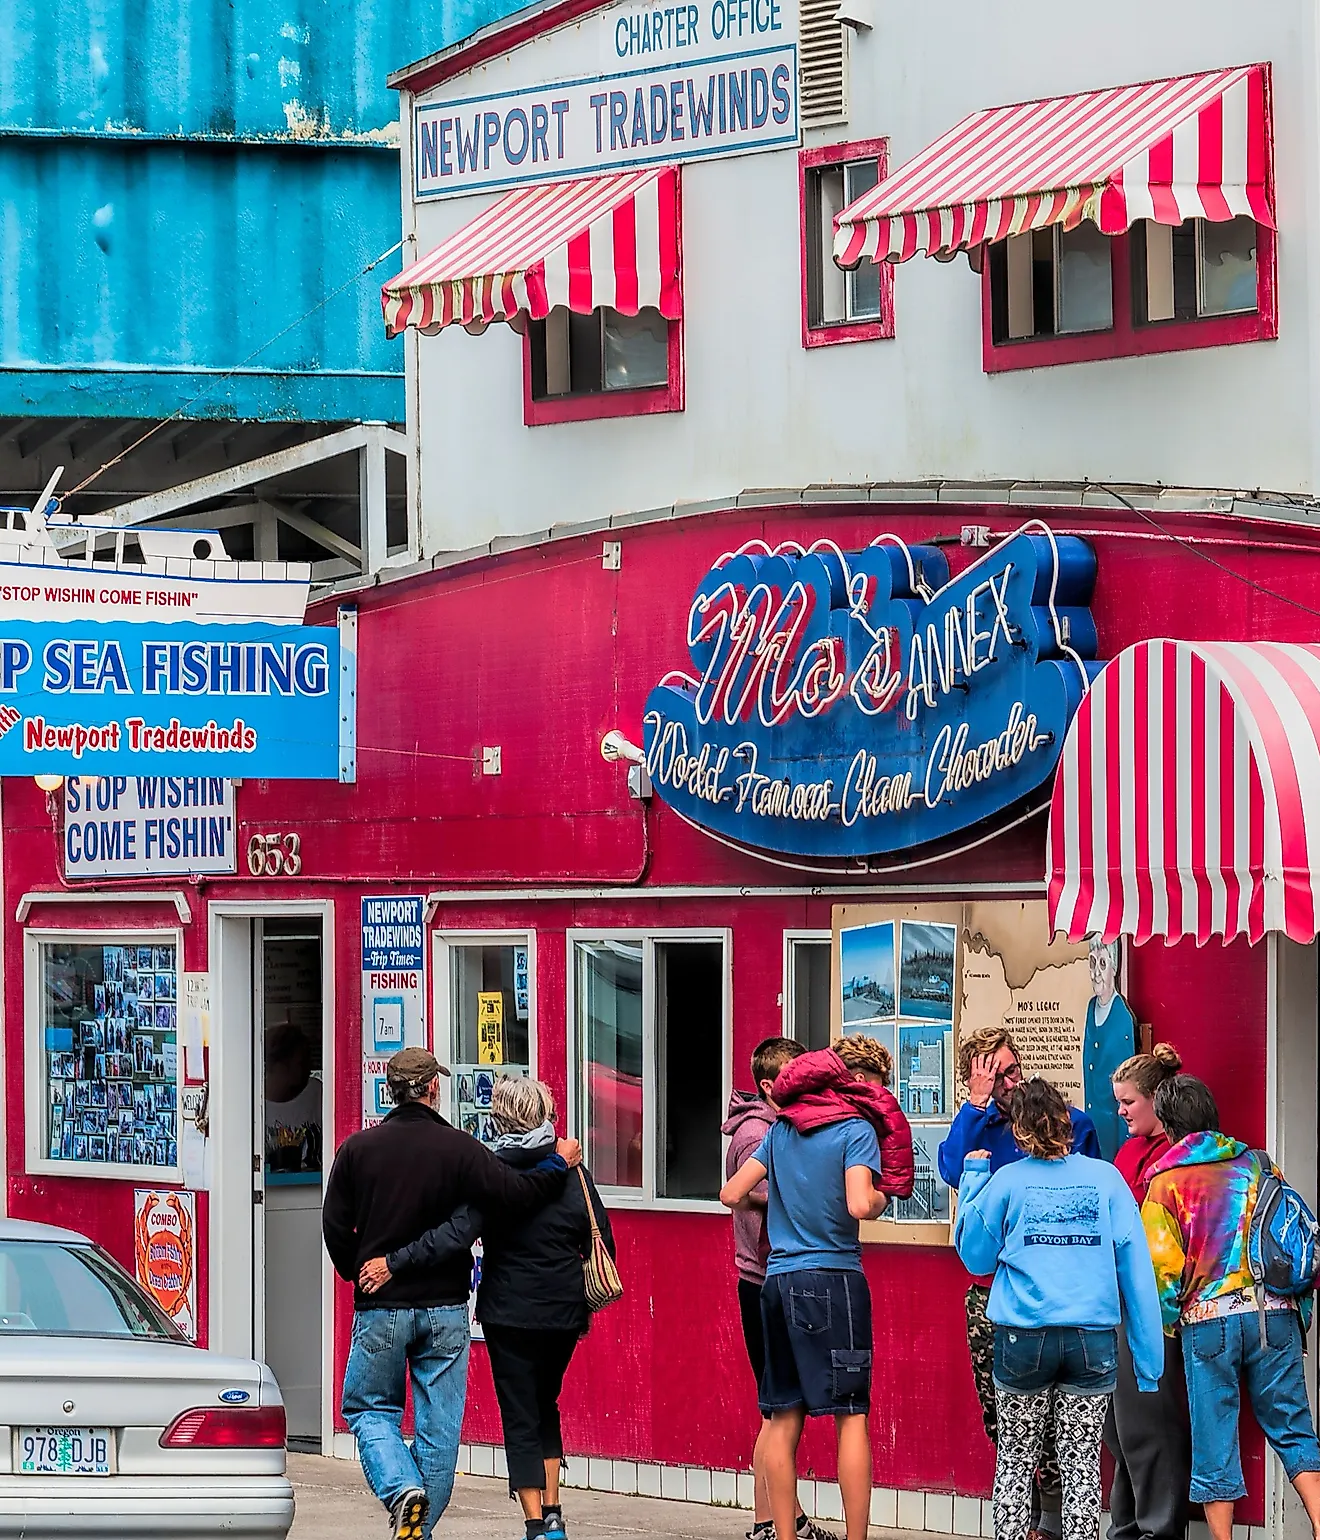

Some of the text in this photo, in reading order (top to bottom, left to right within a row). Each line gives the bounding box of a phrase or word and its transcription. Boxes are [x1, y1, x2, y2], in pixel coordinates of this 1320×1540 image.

[615, 0, 782, 57] CHARTER OFFICE
[421, 63, 791, 179] NEWPORT TRADEWINDS
[45, 587, 95, 603] WISHIN
[99, 589, 142, 605] COME
[145, 591, 199, 607] FISHIN"
[687, 563, 1014, 727] Mo's ANNEX
[43, 639, 133, 694] SEA
[142, 641, 330, 696] FISHING
[25, 716, 119, 758] Newport
[127, 718, 257, 752] Tradewinds
[643, 701, 1044, 827] World Famous Clam Chowder
[67, 776, 126, 813] STOP
[67, 816, 232, 863] COME FISHIN'
[248, 833, 302, 876] 653
[367, 900, 418, 924] NEWPORT
[363, 925, 422, 949] TRADEWINDS
[370, 950, 415, 970] Trip Times
[370, 972, 418, 990] FISHING
[1017, 1001, 1060, 1012] MO'S LEGACY
[378, 1017, 394, 1036] 7am
[151, 1213, 178, 1227] COMBO
[1031, 1235, 1094, 1245] TOYON BAY
[47, 1427, 81, 1438] Oregon
[24, 1437, 107, 1463] 978 DJB
